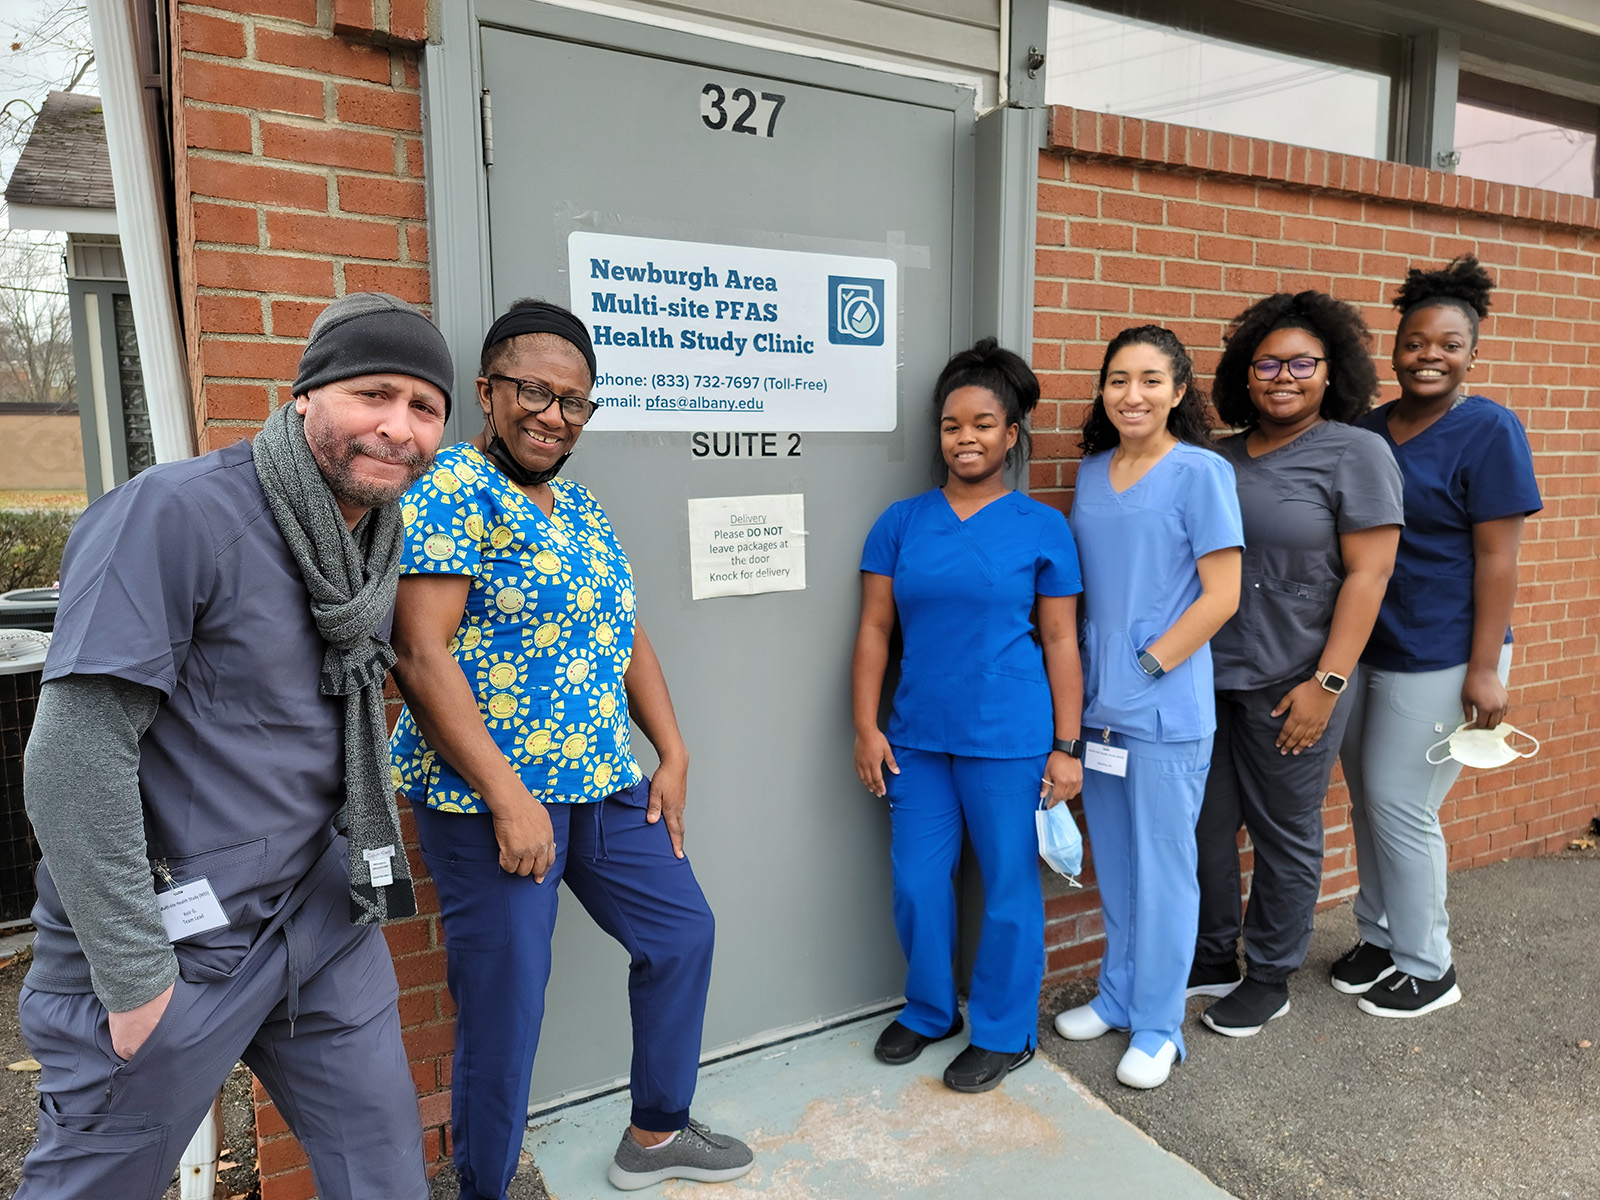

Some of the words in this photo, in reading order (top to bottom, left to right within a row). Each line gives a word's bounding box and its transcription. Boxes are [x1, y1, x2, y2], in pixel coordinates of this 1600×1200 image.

[701, 83, 786, 138] 327
[590, 258, 718, 292] Newburgh
[725, 269, 778, 292] Area
[591, 292, 710, 320] Multi-site
[715, 300, 778, 322] PFAS
[593, 325, 674, 349] Health
[680, 329, 748, 356] Study
[753, 333, 815, 354] Clinic
[596, 373, 647, 388] phone:
[651, 374, 690, 390] (833)
[693, 375, 760, 390] 732-7697
[763, 376, 828, 393] (Toll-Free)
[596, 394, 641, 408] email:
[645, 395, 764, 413] pfas@albany.edu
[692, 432, 778, 457] SUITE
[787, 433, 802, 457] 2
[730, 514, 767, 526] Delivery
[714, 530, 745, 540] Please
[747, 528, 762, 538] DO
[763, 526, 783, 536] NOT
[709, 544, 735, 555] leave
[737, 541, 778, 554] packages
[779, 540, 789, 549] at
[731, 556, 747, 566] the
[748, 555, 770, 565] door
[709, 572, 738, 582] Knock
[740, 569, 753, 580] for
[755, 567, 791, 579] delivery
